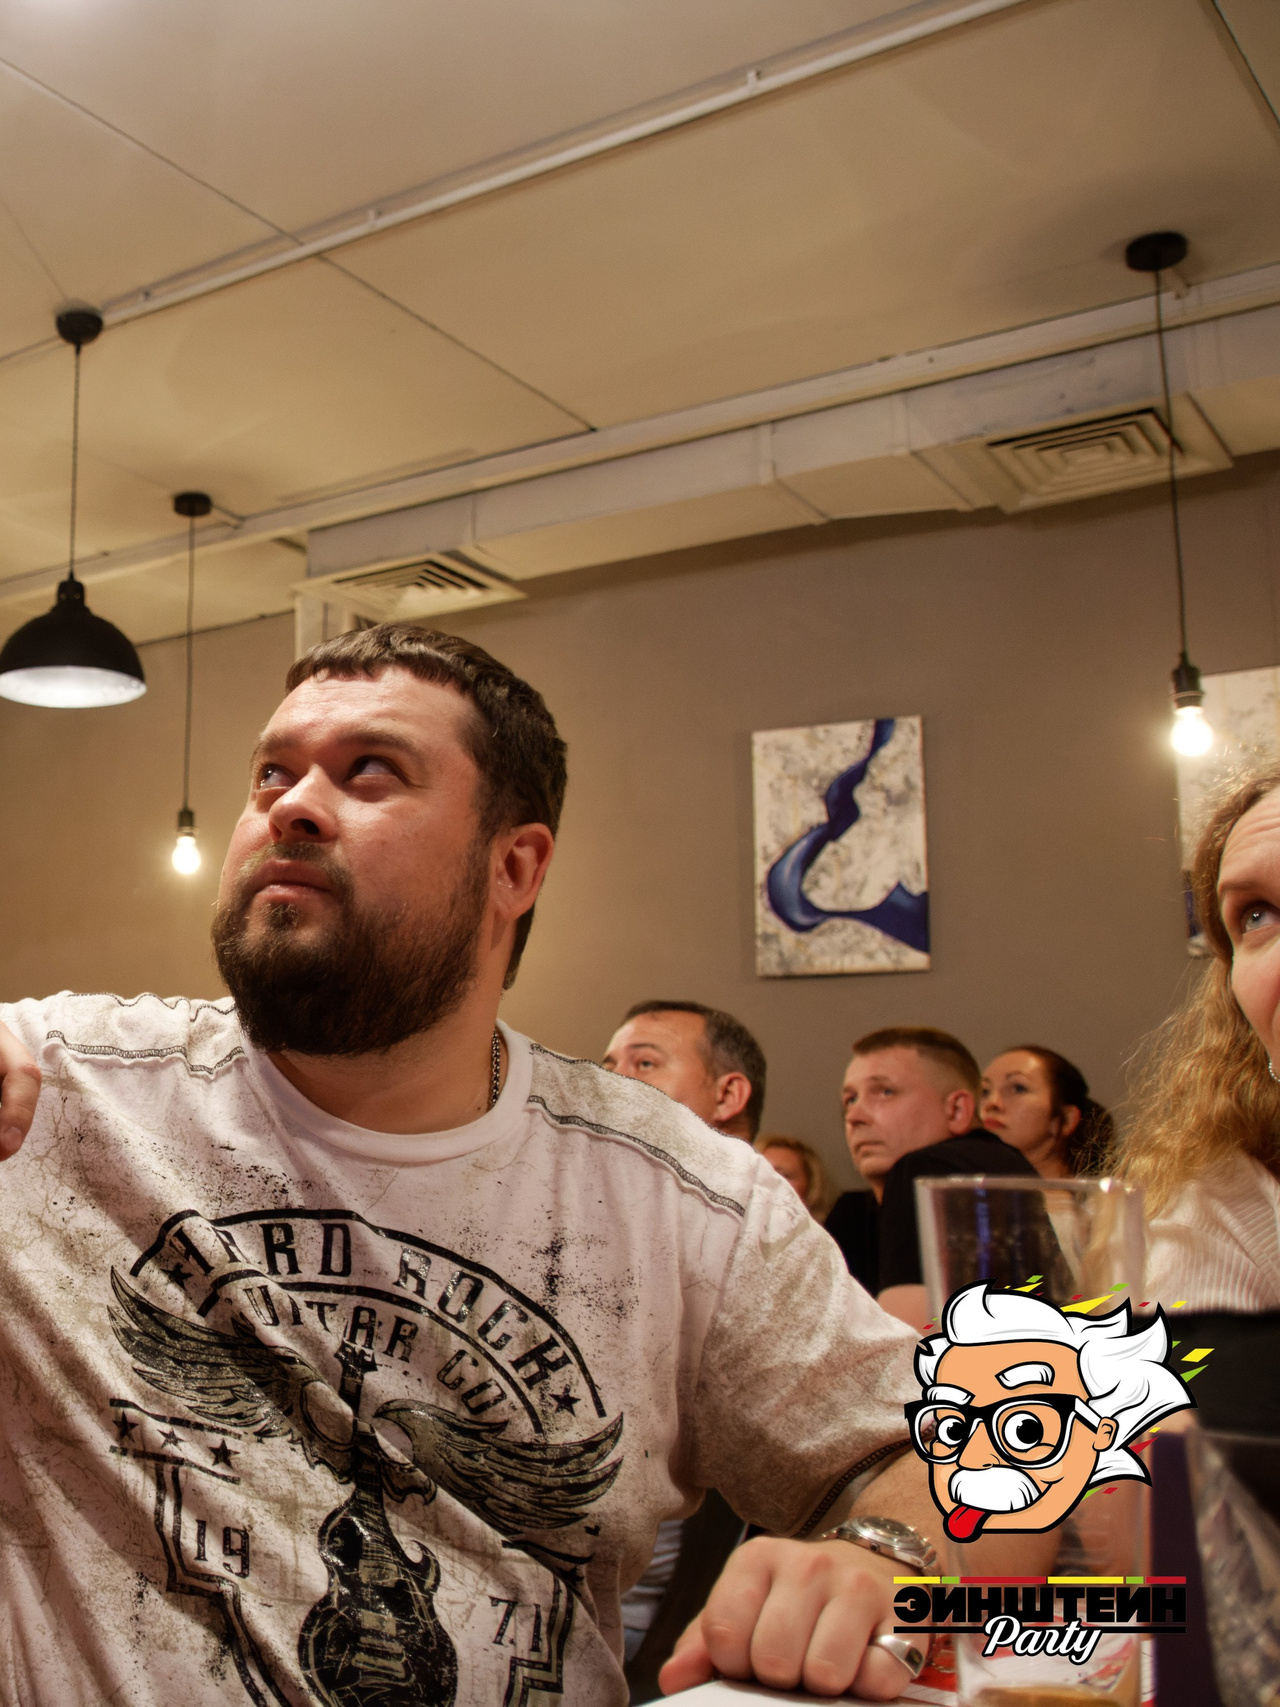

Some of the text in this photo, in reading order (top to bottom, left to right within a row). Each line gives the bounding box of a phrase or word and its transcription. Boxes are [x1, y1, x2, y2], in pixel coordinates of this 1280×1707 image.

[392, 1246, 572, 1390] ROCK
[194, 1519, 250, 1579] 19
[488, 1596, 542, 1652] 71
